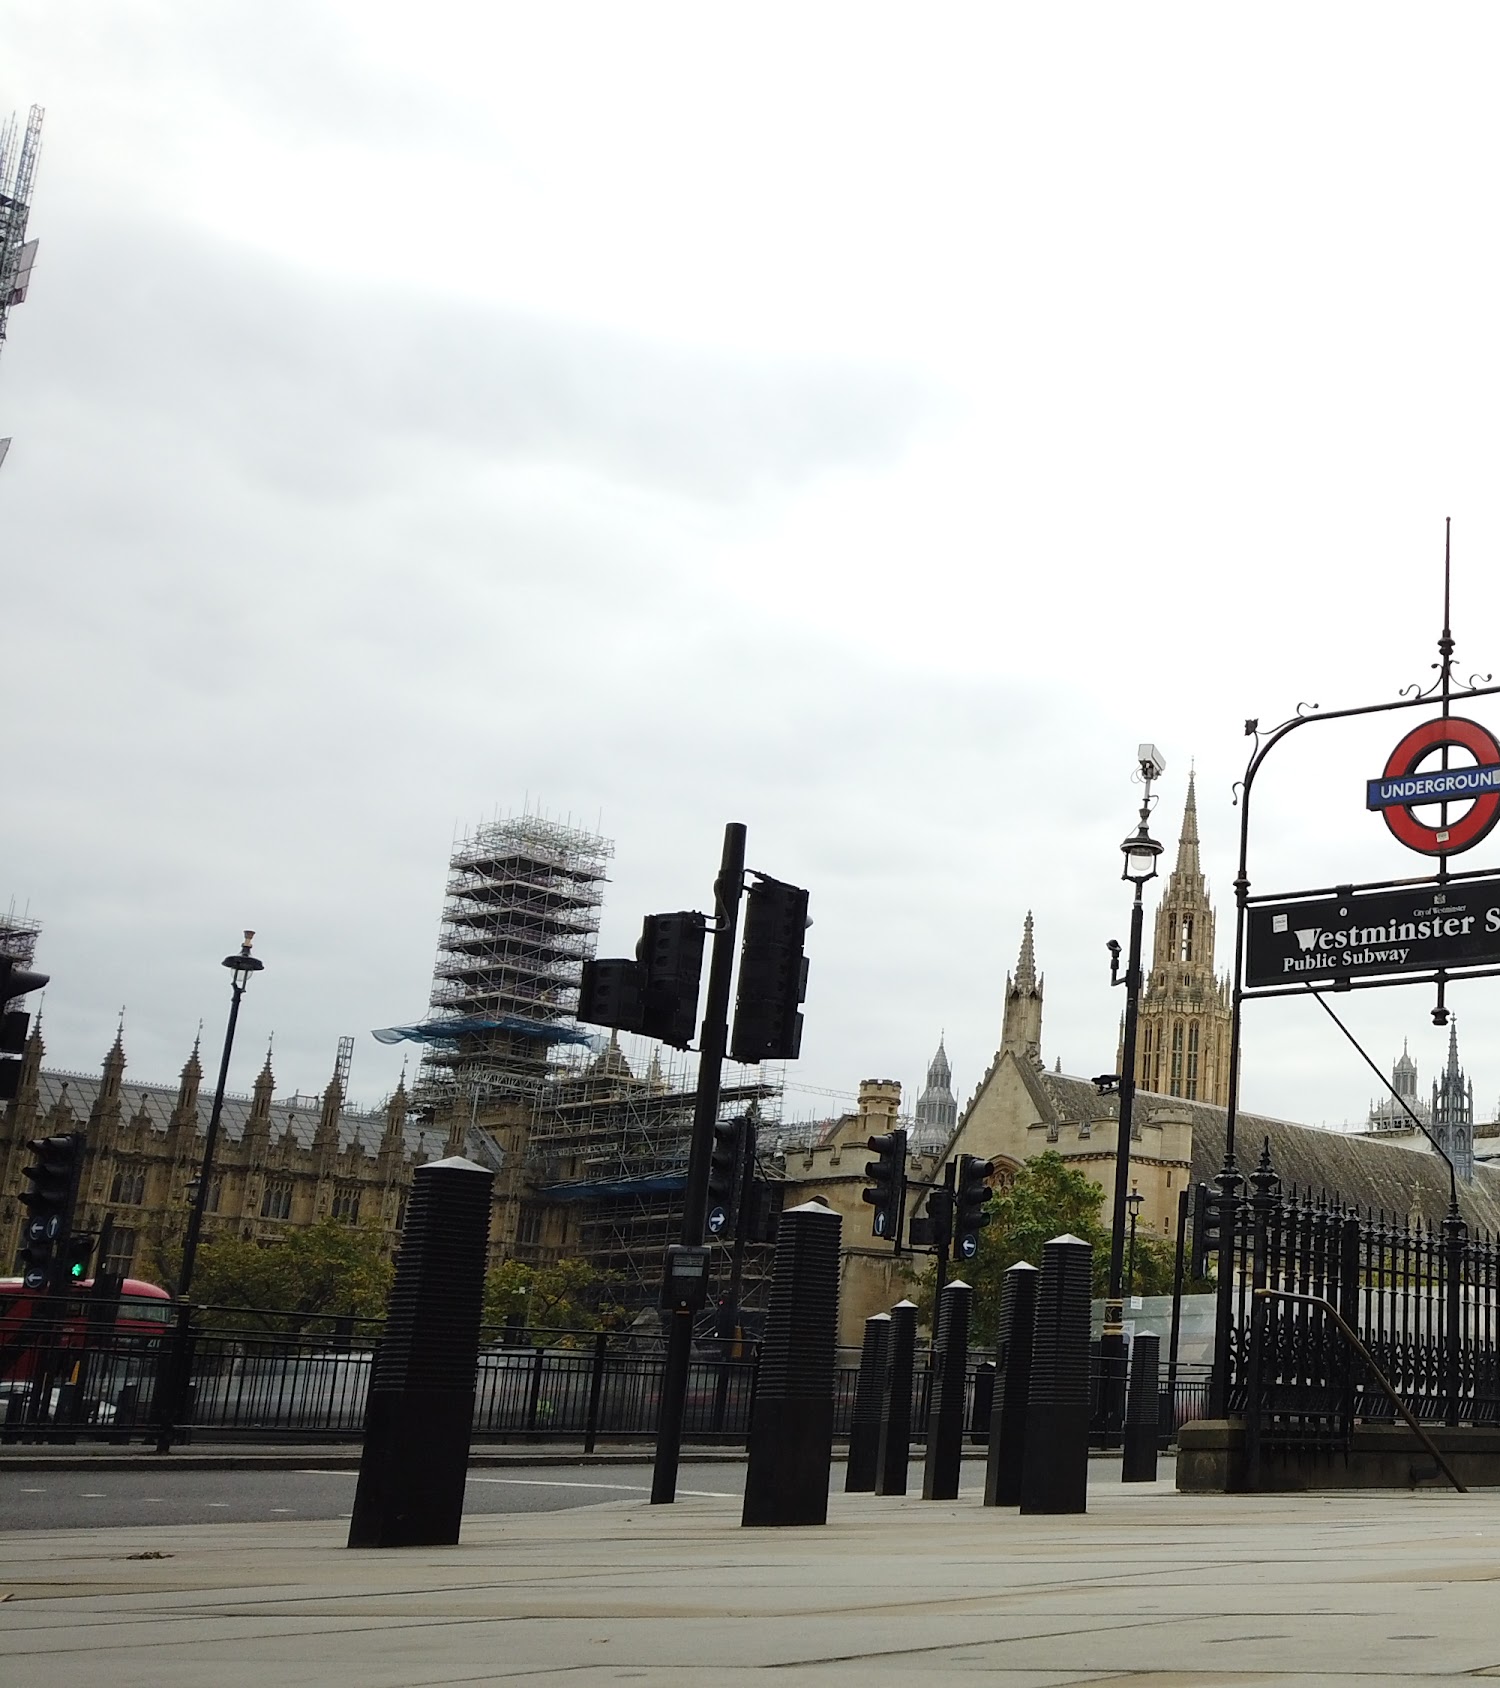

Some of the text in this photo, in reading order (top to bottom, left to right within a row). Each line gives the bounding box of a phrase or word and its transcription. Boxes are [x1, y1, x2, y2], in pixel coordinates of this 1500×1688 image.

[1294, 915, 1475, 953] Westminster
[1283, 947, 1410, 973] Public Subway
